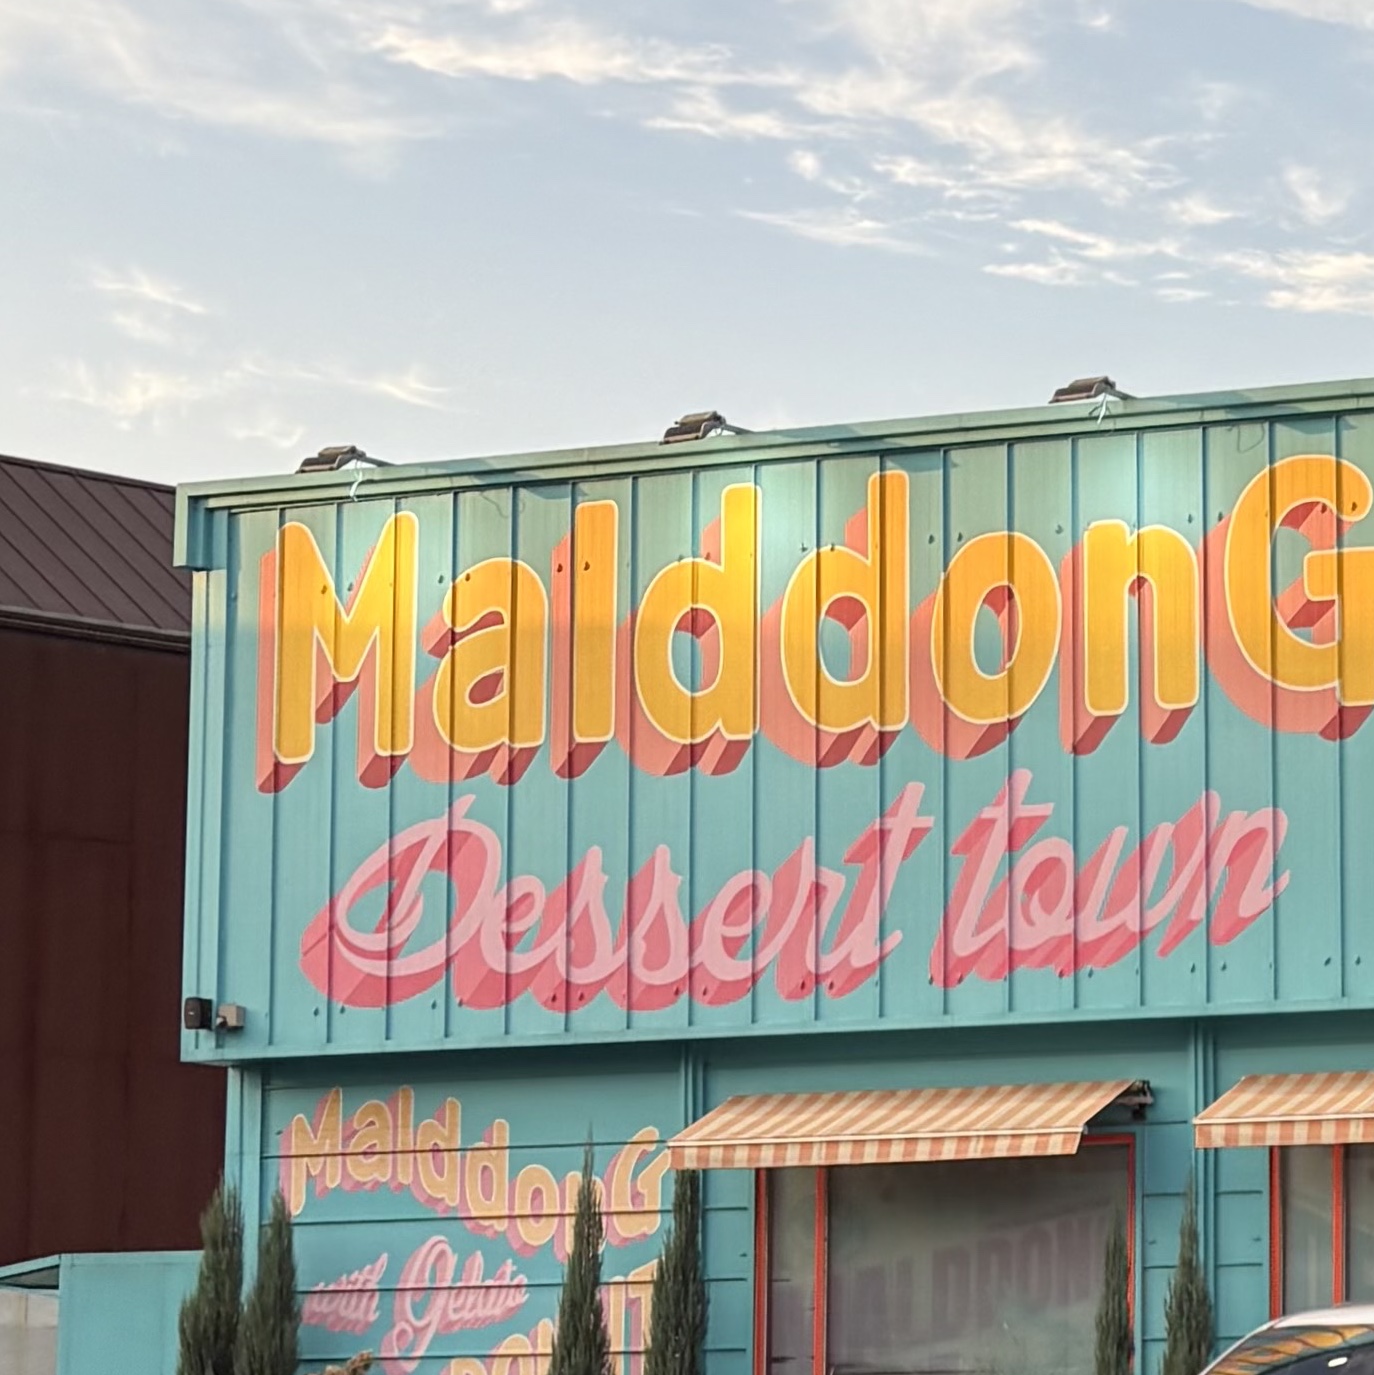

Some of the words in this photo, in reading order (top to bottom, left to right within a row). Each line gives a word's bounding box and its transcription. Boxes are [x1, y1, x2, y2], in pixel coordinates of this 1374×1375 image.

[300, 782, 933, 1013] Dessert
[929, 768, 1290, 989] town
[302, 1253, 388, 1335] with
